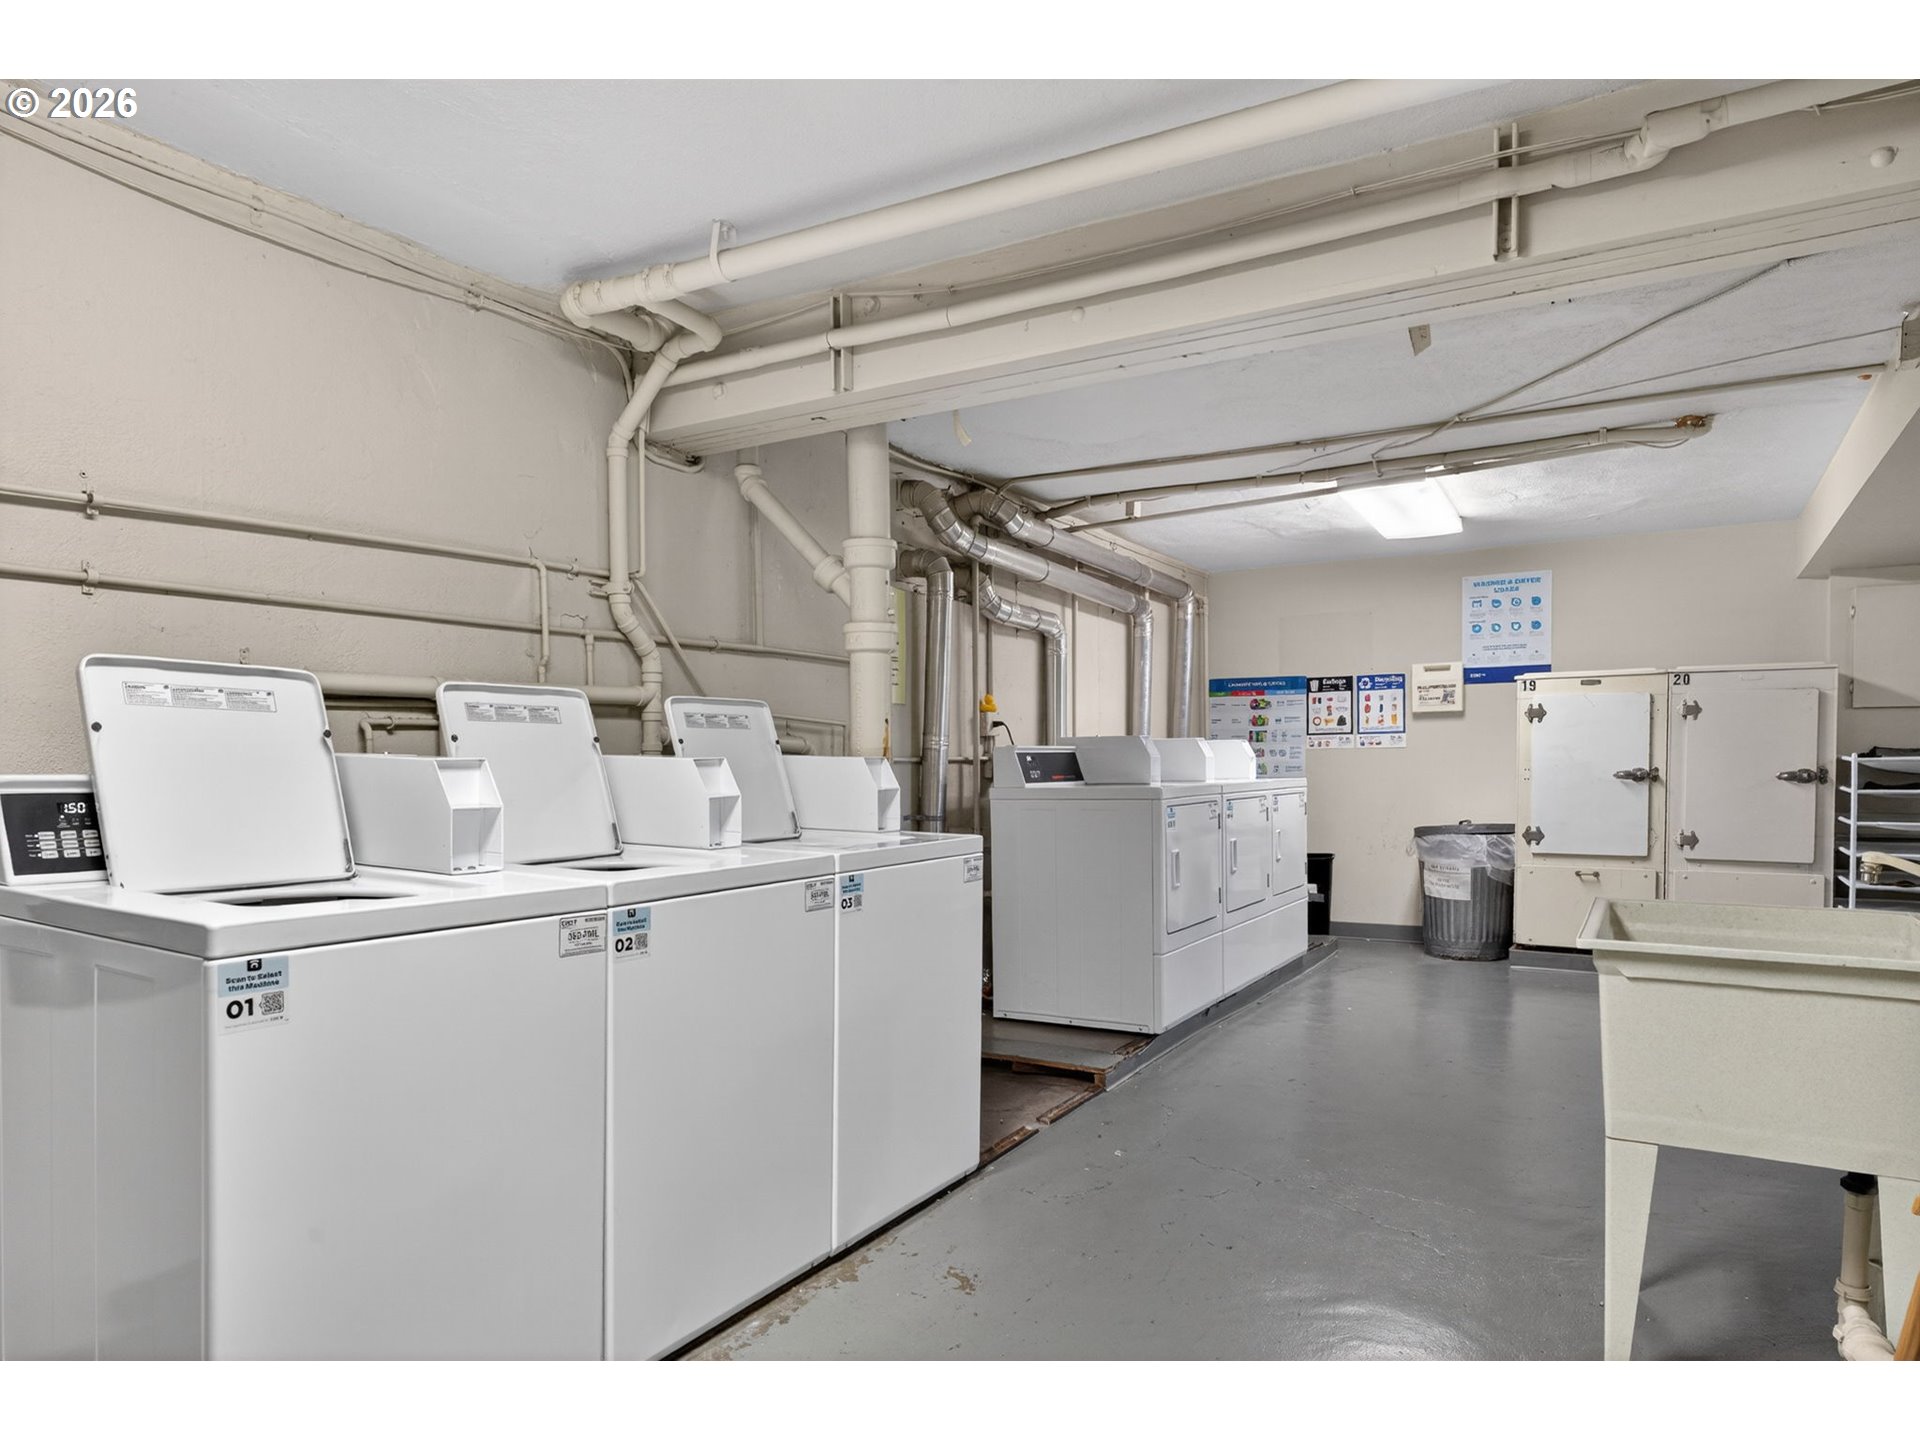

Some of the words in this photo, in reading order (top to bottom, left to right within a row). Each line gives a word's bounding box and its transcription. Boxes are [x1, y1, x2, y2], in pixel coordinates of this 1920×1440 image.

[1521, 679, 1536, 691] 19
[1673, 673, 1690, 686] 20
[841, 897, 853, 910] 03
[615, 937, 633, 953] 02
[226, 998, 254, 1019] 01
